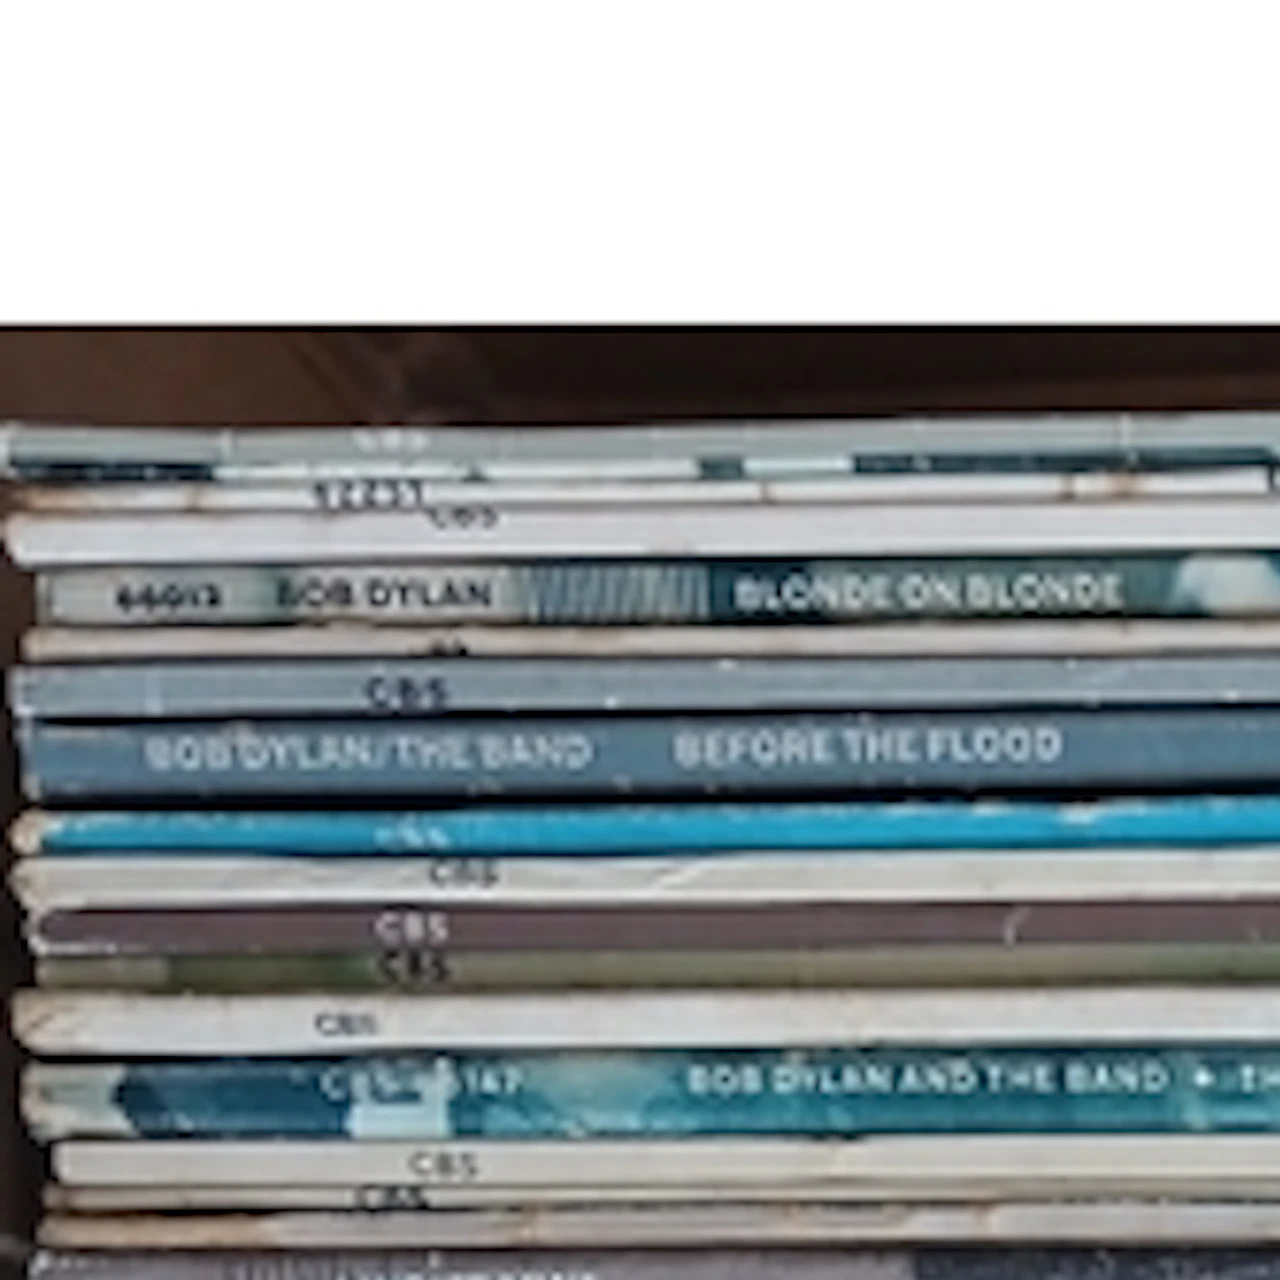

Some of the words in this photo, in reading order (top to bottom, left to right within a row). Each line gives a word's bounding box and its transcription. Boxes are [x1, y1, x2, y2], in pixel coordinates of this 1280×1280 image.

[279, 580, 353, 608] BOB
[367, 579, 493, 608] DYLAN
[734, 574, 891, 612] BLONDE
[967, 572, 1125, 611] BLONDE
[484, 732, 594, 772] BAND
[674, 728, 834, 768] BEFORE
[842, 726, 920, 764] THE
[926, 725, 1063, 763] FLOOD
[375, 913, 452, 943] CBS
[688, 1063, 761, 1095] BOB
[772, 1063, 891, 1095] DYLAN
[898, 1063, 976, 1094] AND
[986, 1063, 1052, 1093] THE
[1064, 1063, 1168, 1094] BAND
[407, 1151, 479, 1180] CBS
